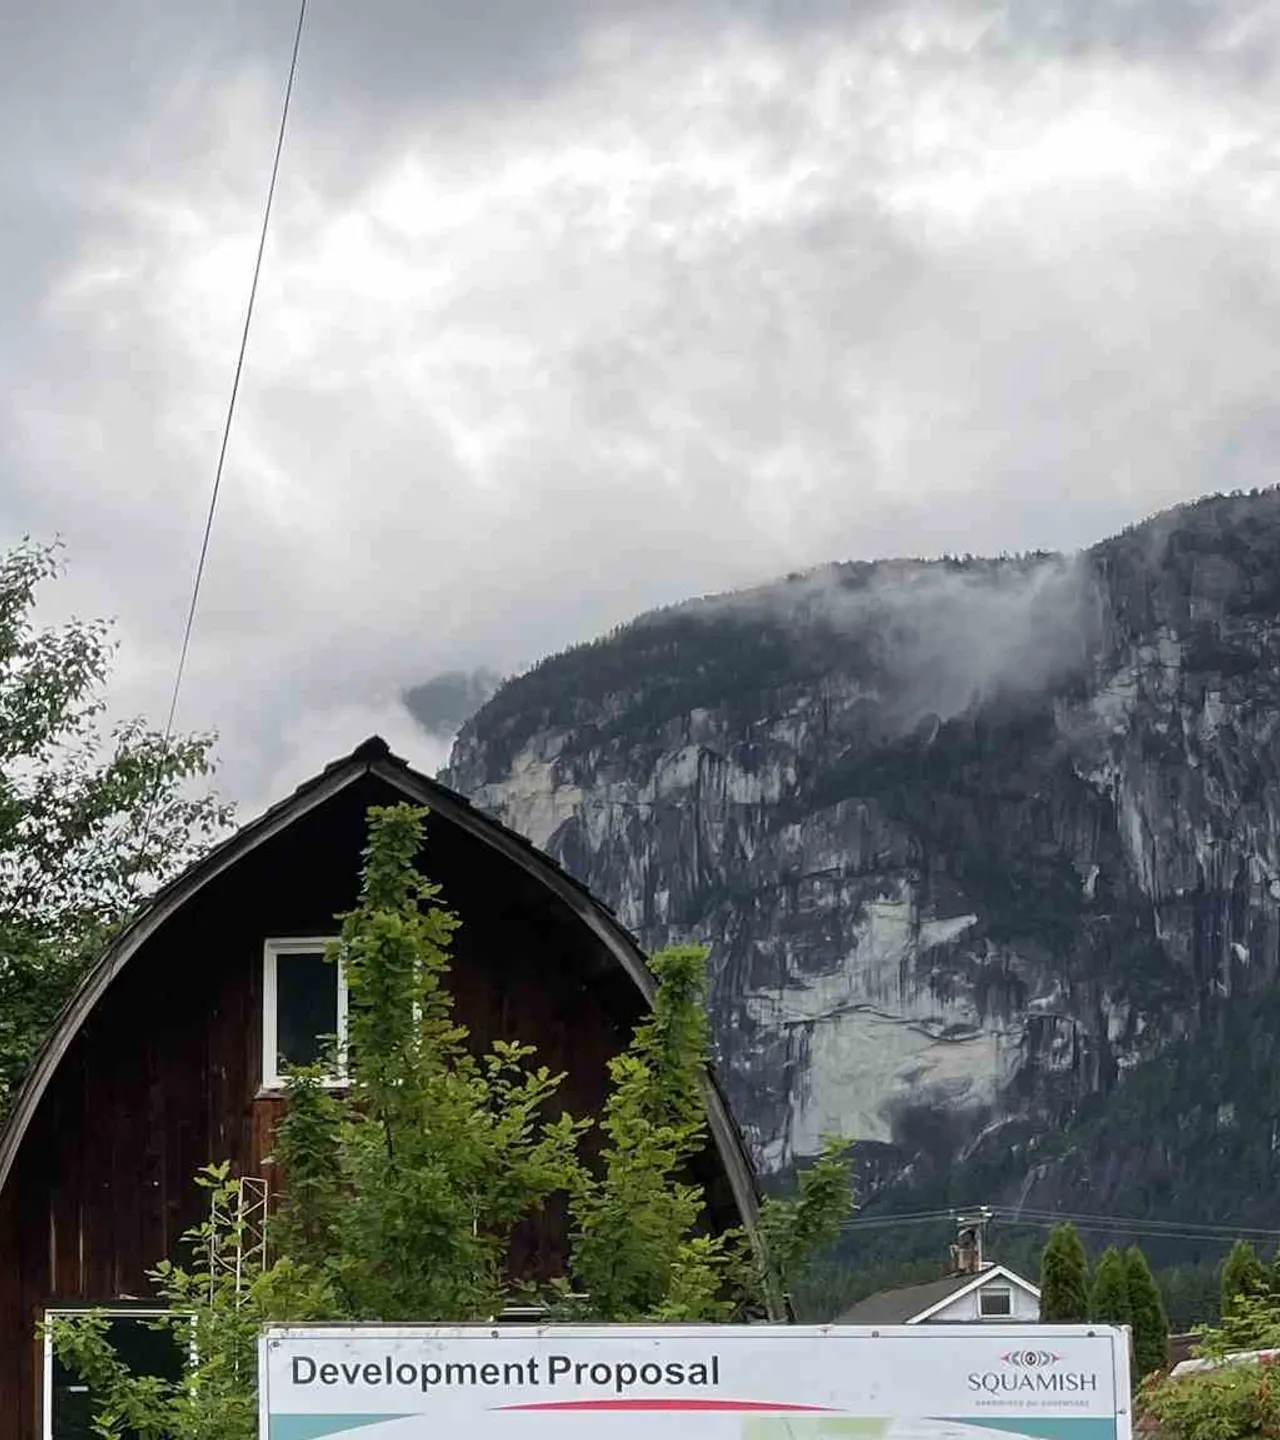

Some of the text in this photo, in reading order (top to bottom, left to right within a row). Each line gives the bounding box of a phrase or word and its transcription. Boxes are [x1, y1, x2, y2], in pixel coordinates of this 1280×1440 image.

[291, 1355, 720, 1392] Development Proposal
[968, 1372, 1096, 1396] SQUAMISH
